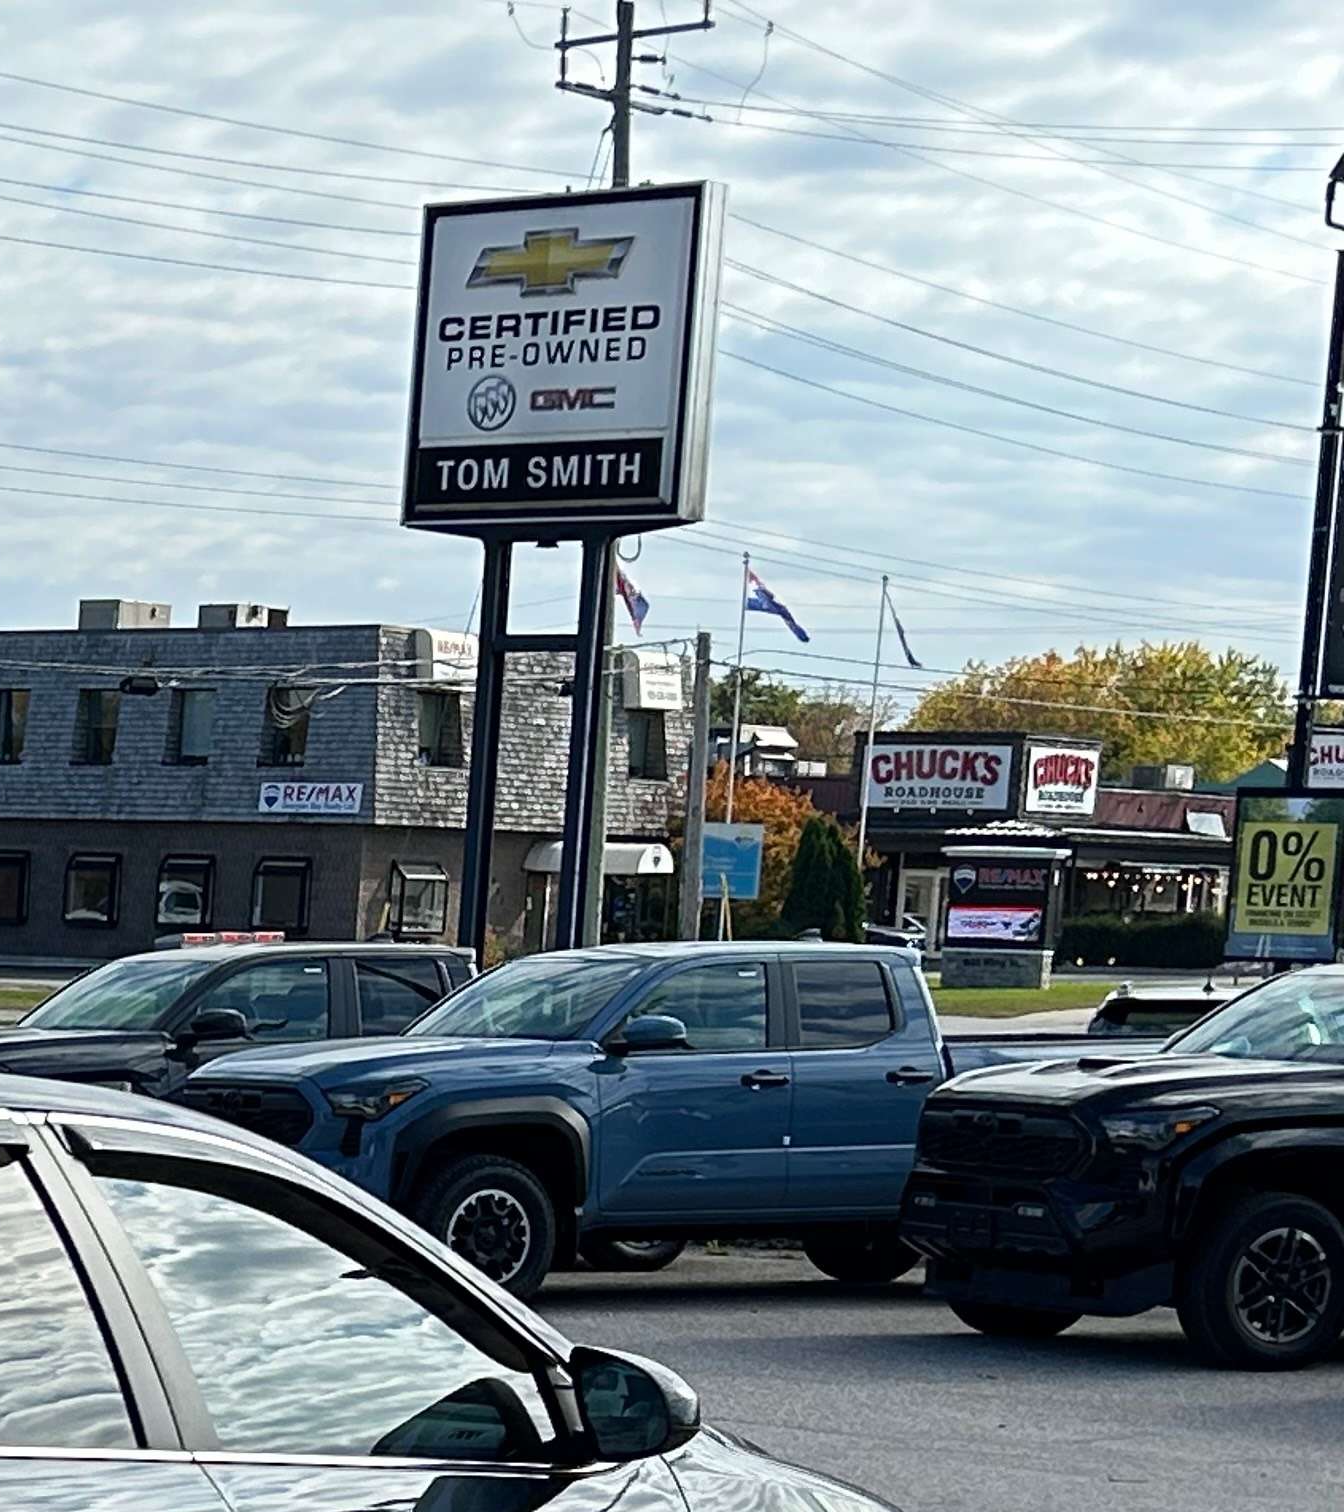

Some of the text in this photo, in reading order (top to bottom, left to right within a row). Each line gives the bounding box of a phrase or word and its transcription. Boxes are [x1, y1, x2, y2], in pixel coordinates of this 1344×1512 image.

[438, 304, 661, 342] CERTIFIED
[446, 336, 647, 371] PRE-OWNED
[529, 386, 617, 412] GMC
[437, 453, 641, 491] TOM SMITH
[871, 748, 1003, 786] CHUCK'S
[1033, 753, 1095, 790] CHUCK'S
[283, 785, 357, 802] RE/MAX
[884, 786, 985, 799] ROADHOUSE
[1248, 828, 1326, 883] 0%
[978, 866, 1042, 885] RE/MAX
[1246, 883, 1322, 909] EVENT
